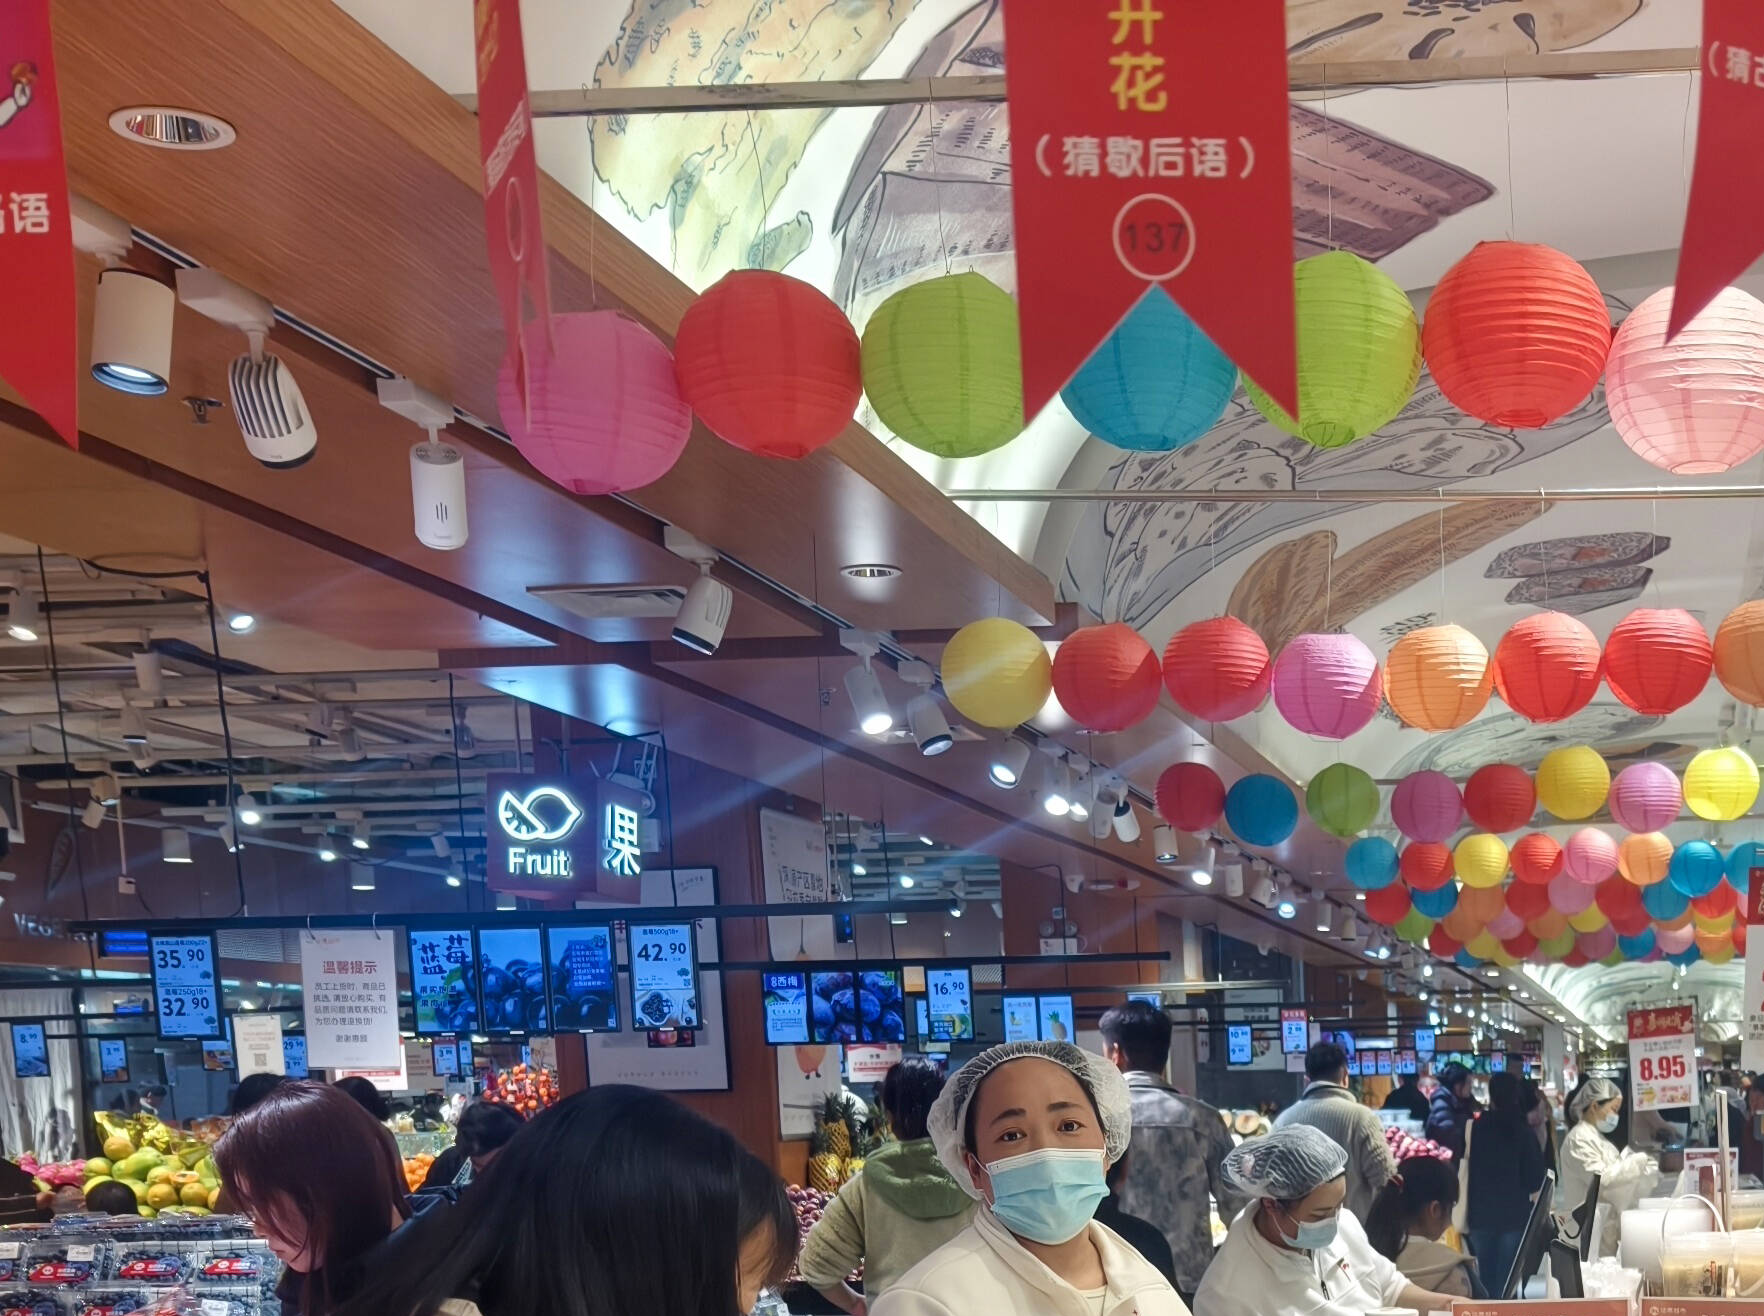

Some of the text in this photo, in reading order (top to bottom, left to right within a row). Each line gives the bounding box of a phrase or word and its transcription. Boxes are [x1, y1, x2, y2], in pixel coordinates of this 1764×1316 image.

[0, 191, 50, 234] 语
[1125, 223, 1186, 253] 137
[605, 801, 641, 876] 果
[508, 847, 571, 877] Fruit
[323, 960, 377, 975] 温馨提示
[1639, 1054, 1686, 1082] 8.95
